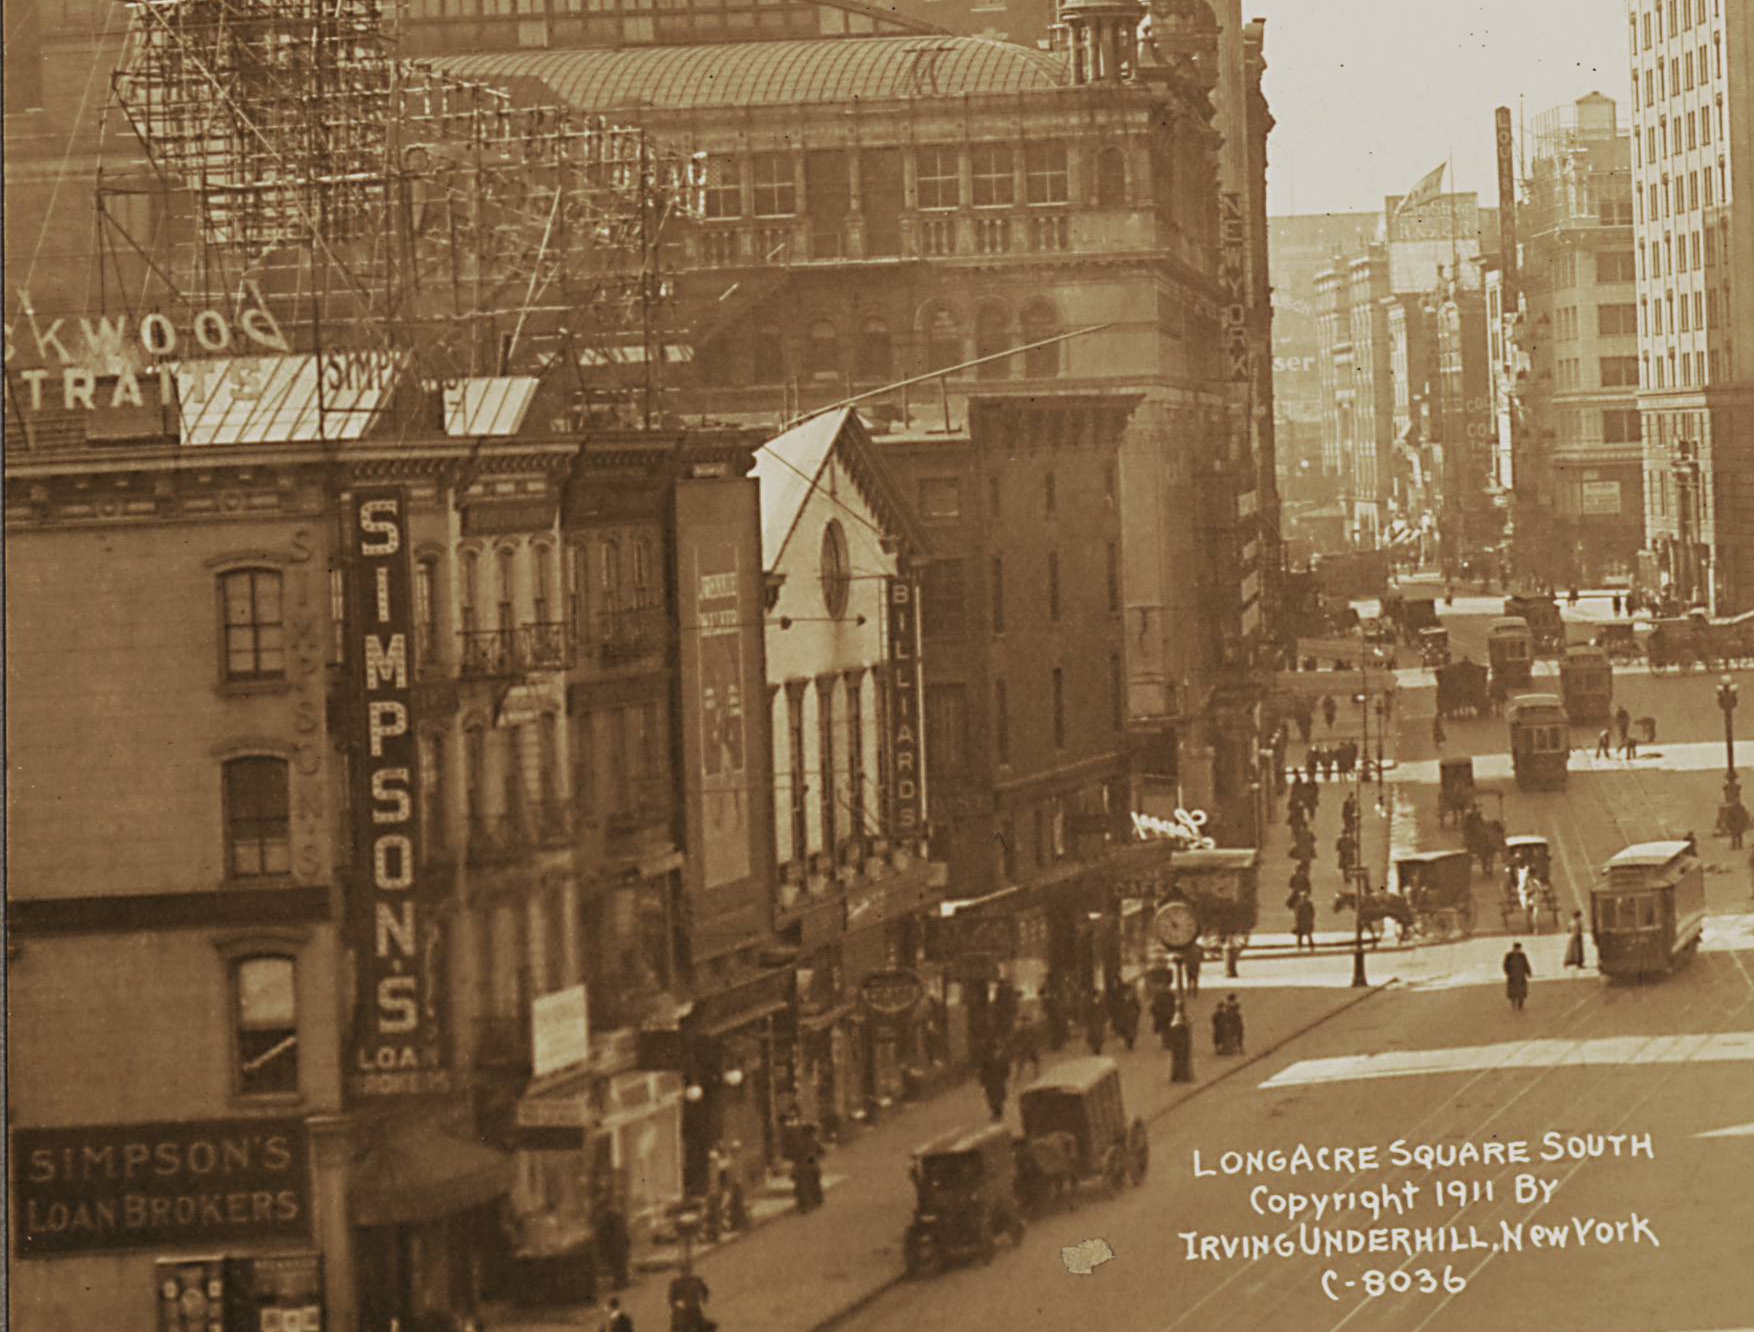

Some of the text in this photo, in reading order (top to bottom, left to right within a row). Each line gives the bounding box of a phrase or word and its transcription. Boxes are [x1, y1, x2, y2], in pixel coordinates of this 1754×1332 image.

[360, 498, 419, 1034] SIMPSON'S
[892, 584, 916, 827] BILLIARDS
[28, 1190, 298, 1233] LOAN BROKERS
[29, 1135, 291, 1182] SIMPSON'S
